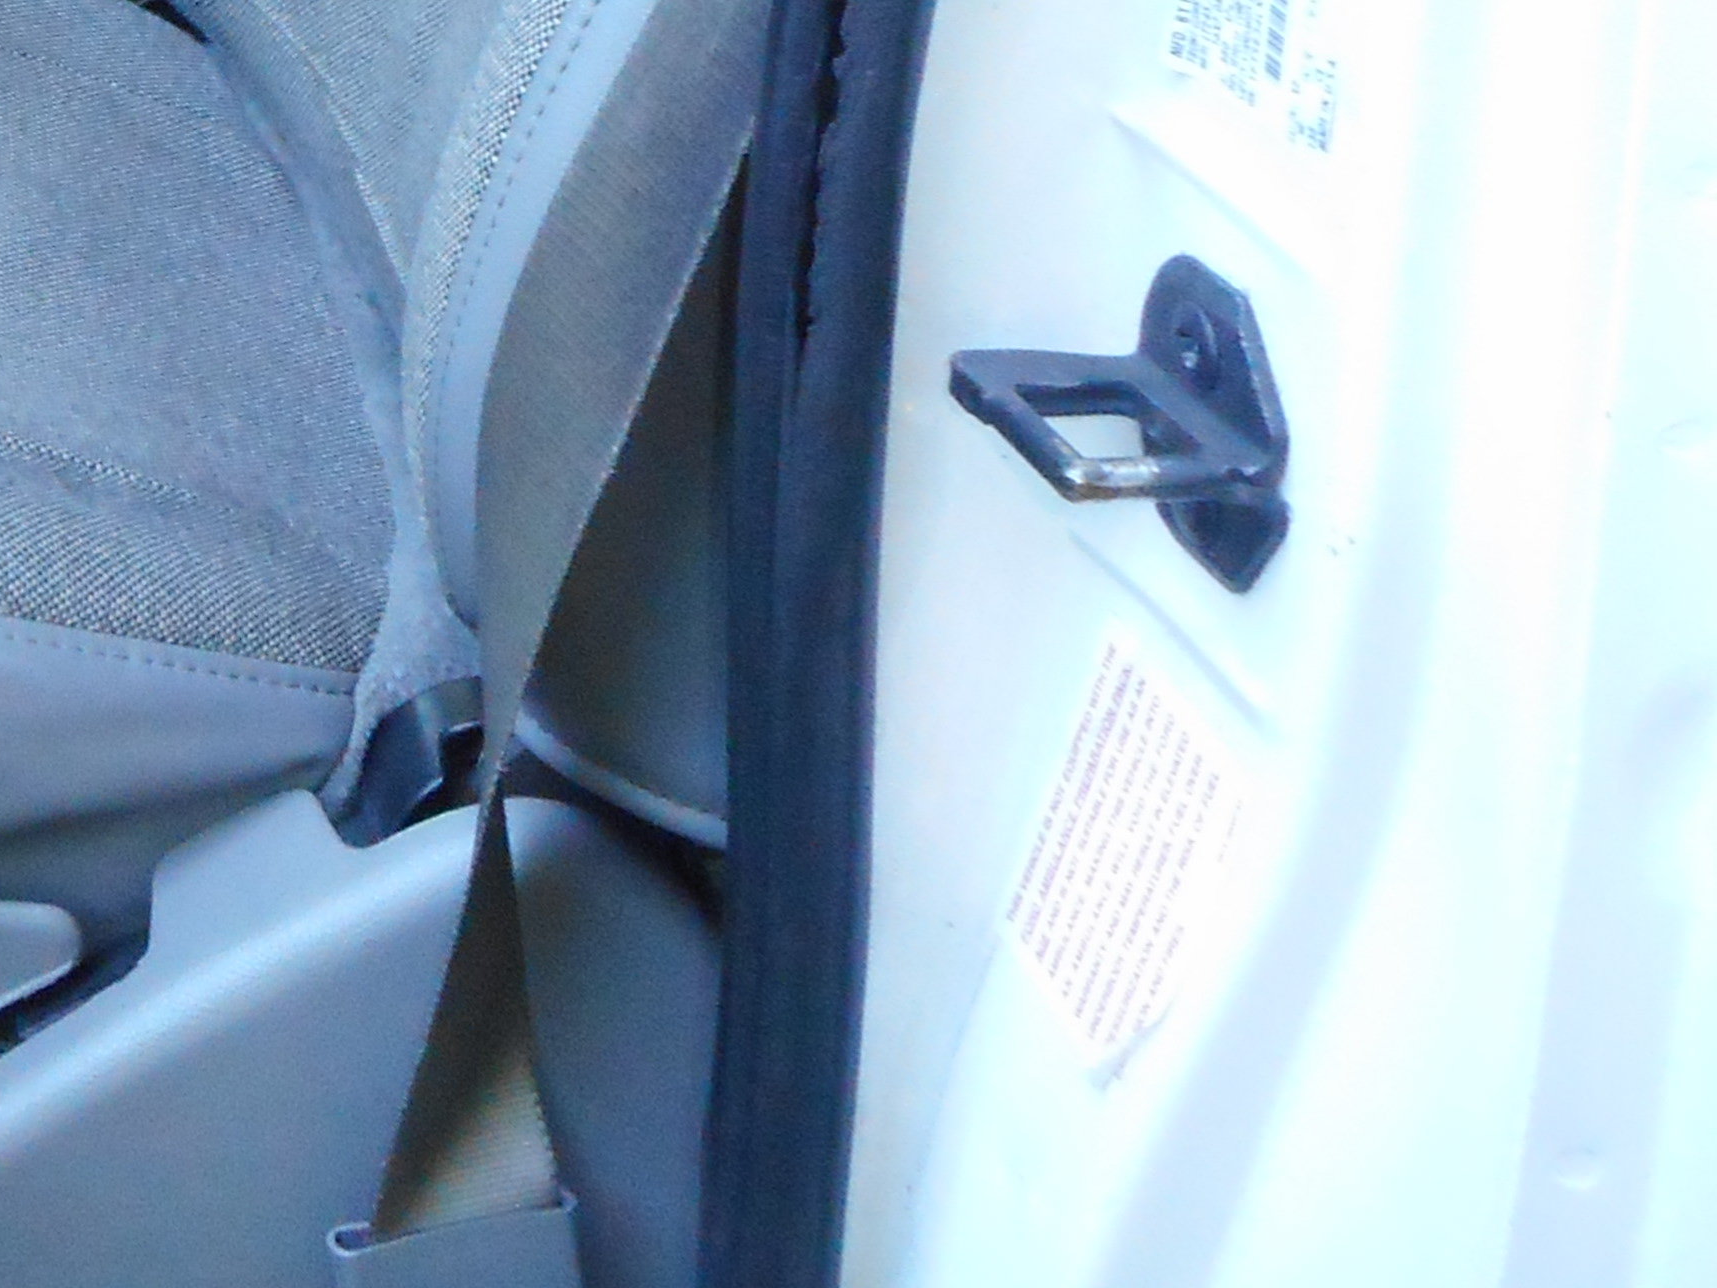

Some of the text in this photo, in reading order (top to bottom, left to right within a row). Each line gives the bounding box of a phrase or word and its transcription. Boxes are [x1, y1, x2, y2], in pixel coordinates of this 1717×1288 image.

[1048, 781, 1065, 816] NOT
[1060, 707, 1093, 783] EQUIPPED
[1087, 670, 1107, 711] WITH
[1101, 640, 1118, 673] THE
